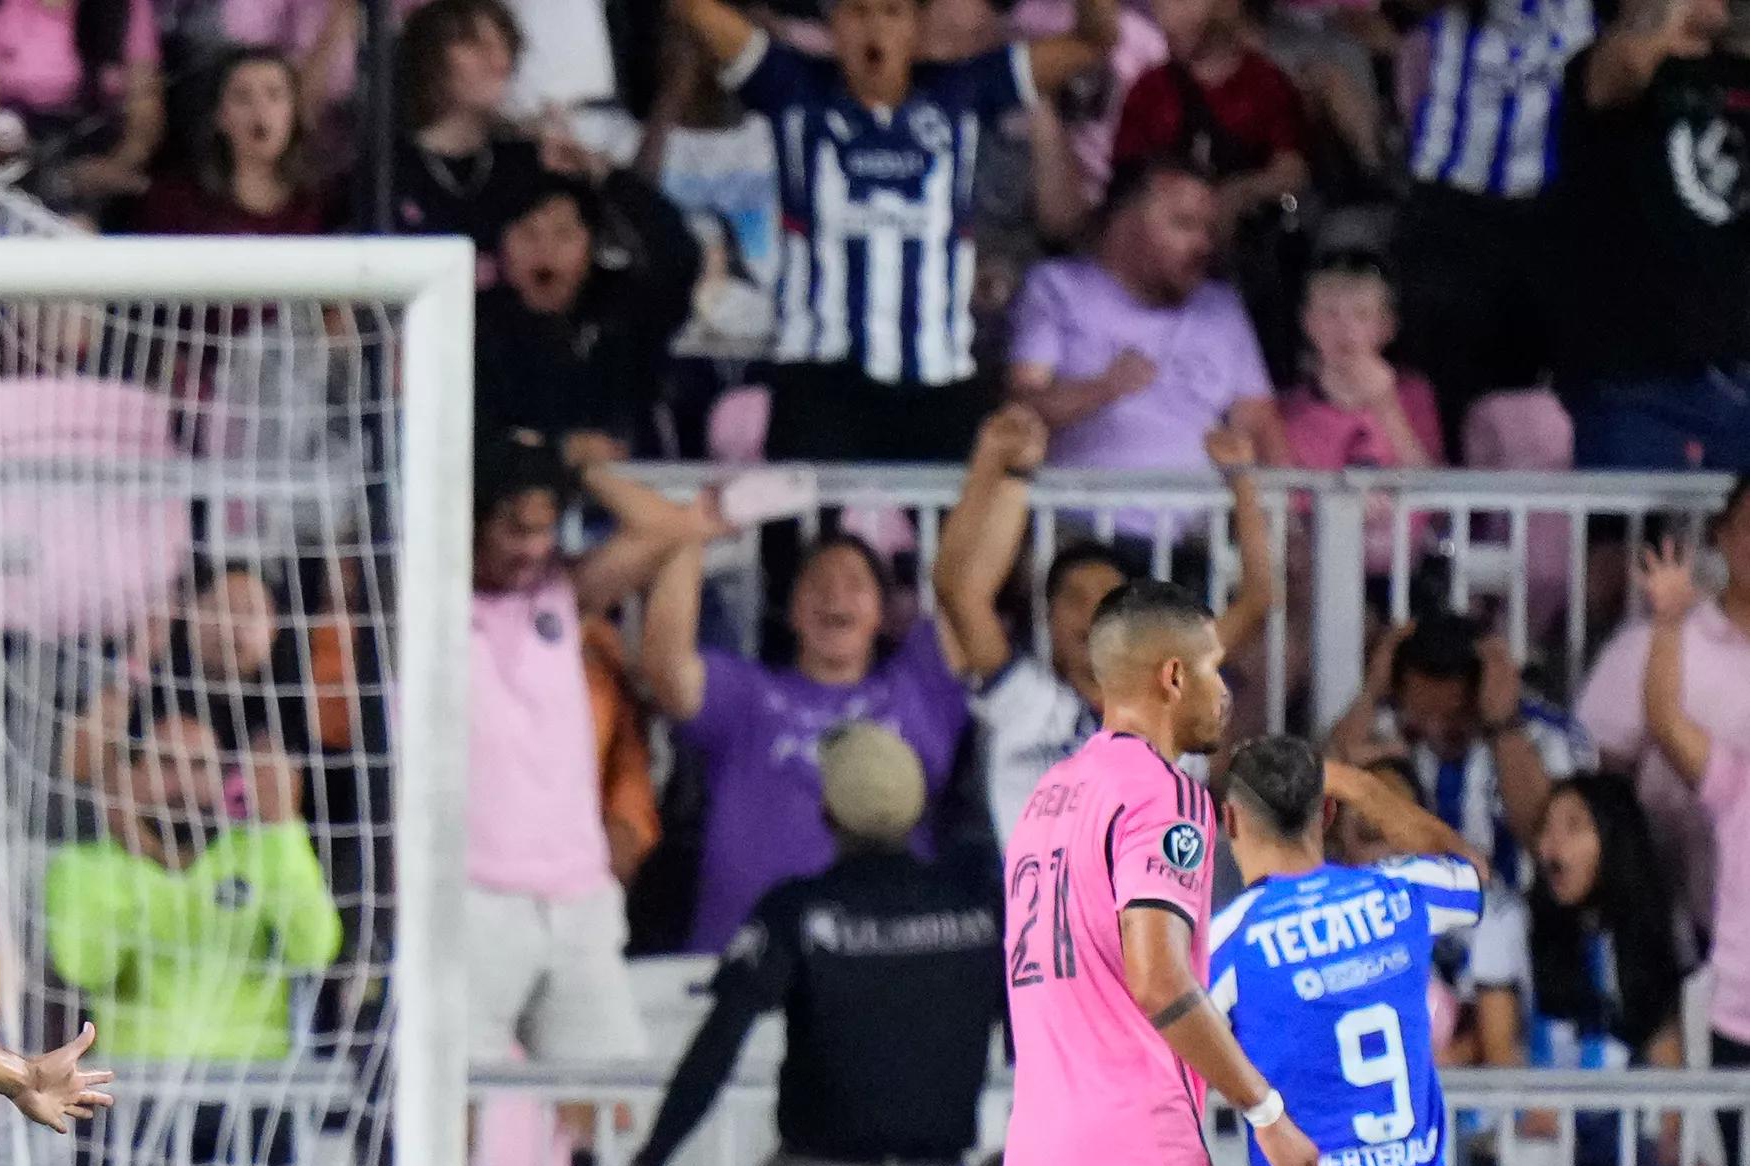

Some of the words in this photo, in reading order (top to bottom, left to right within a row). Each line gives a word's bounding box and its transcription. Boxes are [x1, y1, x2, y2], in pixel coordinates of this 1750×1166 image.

[1010, 847, 1077, 988] 21
[1245, 888, 1396, 969] TECATE
[1334, 1003, 1415, 1144] 9
